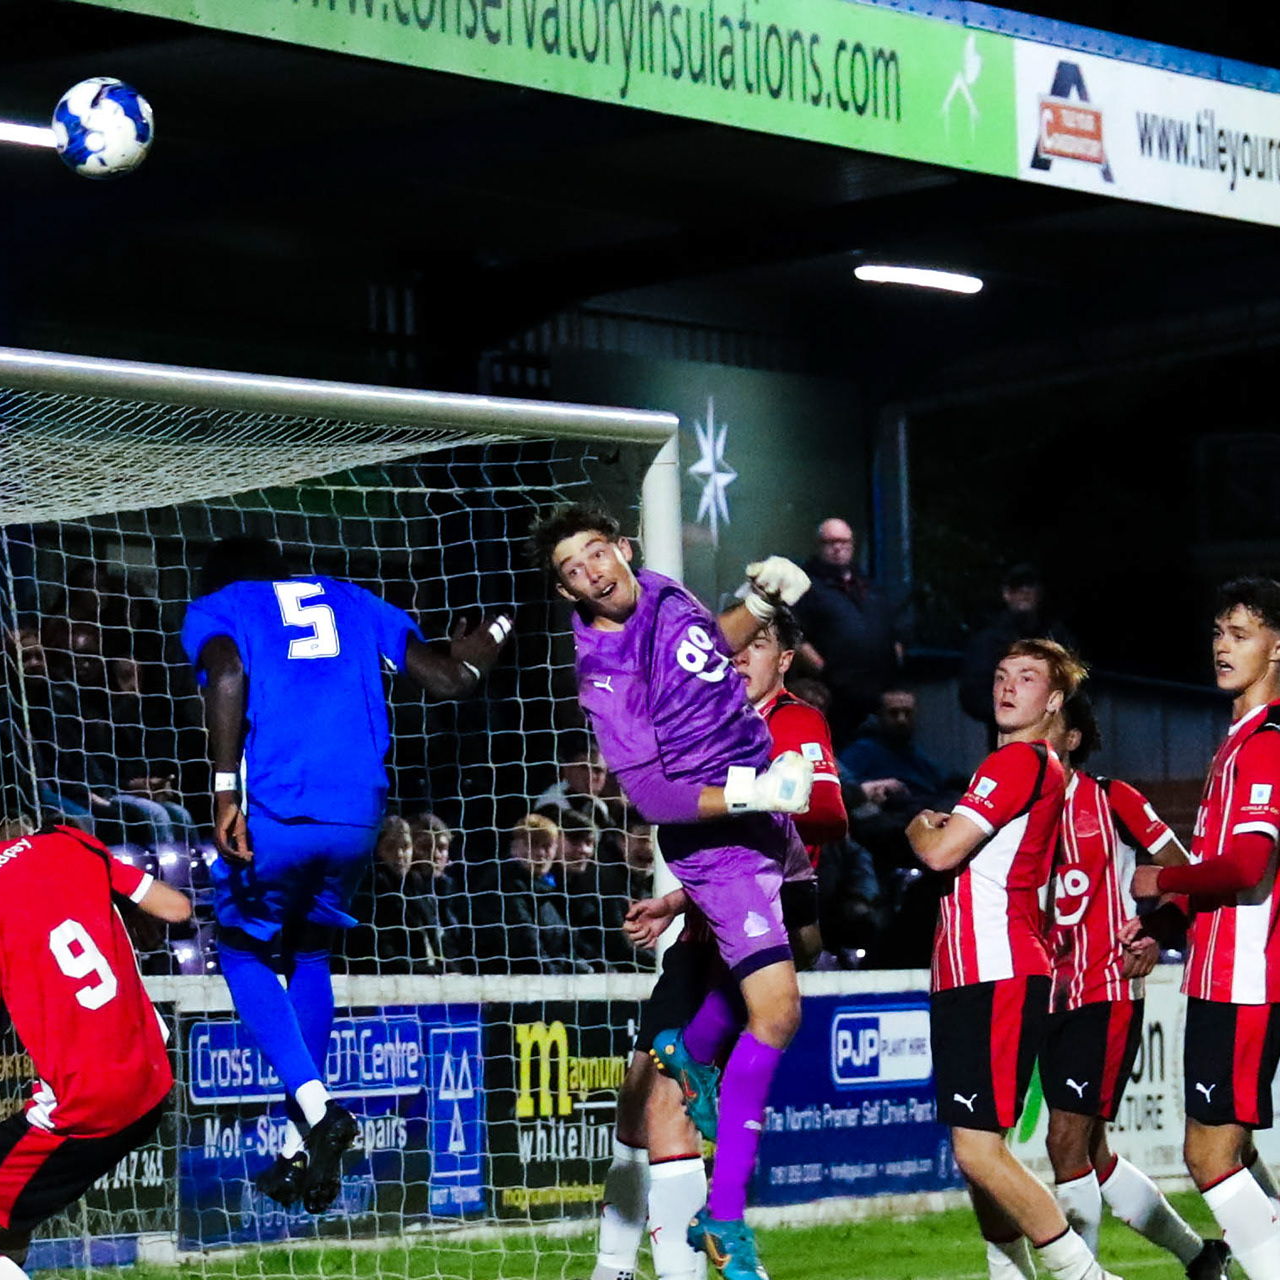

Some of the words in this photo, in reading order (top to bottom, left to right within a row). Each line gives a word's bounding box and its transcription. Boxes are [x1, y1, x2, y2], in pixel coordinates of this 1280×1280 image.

[276, 0, 903, 123] .onservatoryinsulations.com
[273, 582, 340, 659] 5
[49, 918, 118, 1011] 9
[197, 1034, 254, 1088] Cross
[328, 1029, 357, 1083] OT
[360, 1028, 419, 1081] Centre
[837, 1028, 879, 1068] PJP
[204, 1117, 242, 1160] Mot
[354, 1109, 408, 1160] epairs
[521, 1115, 609, 1162] whitelin
[1108, 1093, 1165, 1132] LTURE
